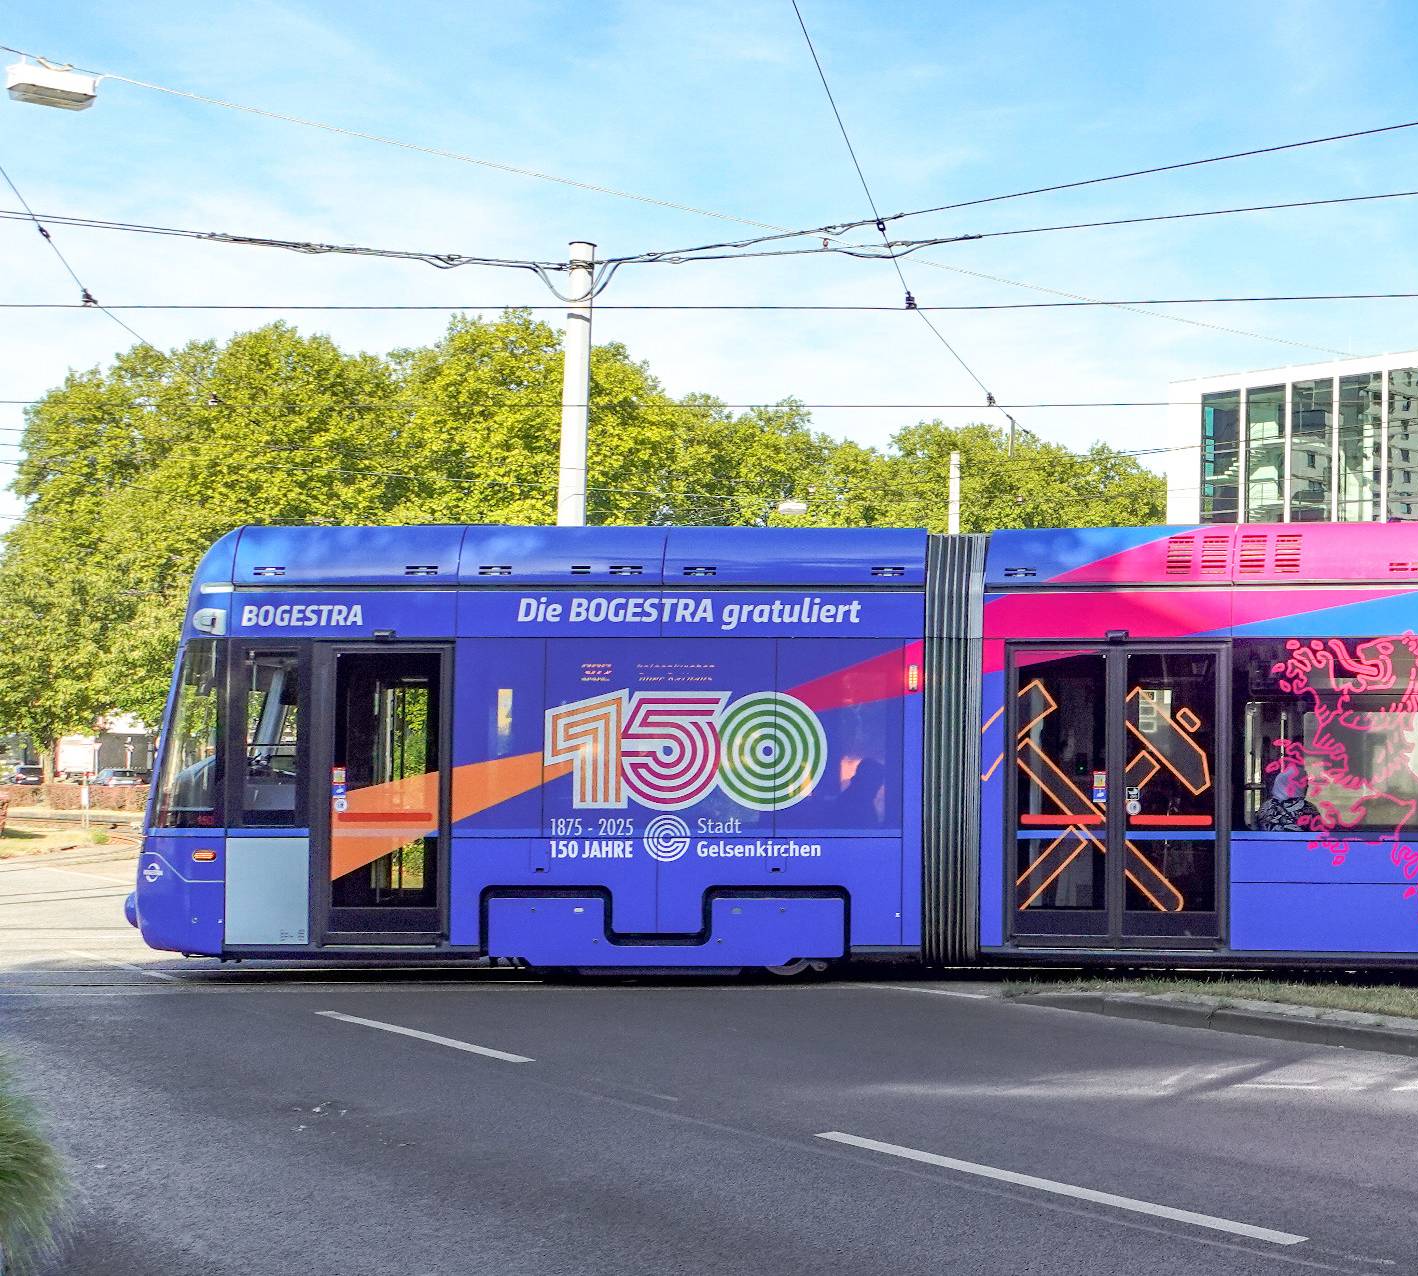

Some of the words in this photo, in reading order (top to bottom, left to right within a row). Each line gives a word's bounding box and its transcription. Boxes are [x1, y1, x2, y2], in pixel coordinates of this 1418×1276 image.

[241, 605, 363, 626] BOGESTRA
[517, 597, 562, 623] Die
[568, 597, 714, 623] BOGESTRA
[721, 597, 862, 630] gratuliert
[544, 688, 828, 812] 150
[550, 819, 583, 836] 1875
[598, 818, 634, 835] 2025
[697, 818, 742, 834] Stadt
[550, 841, 579, 858] 150
[582, 841, 633, 858] JAHRE
[697, 841, 821, 857] Gelsenkirchen
